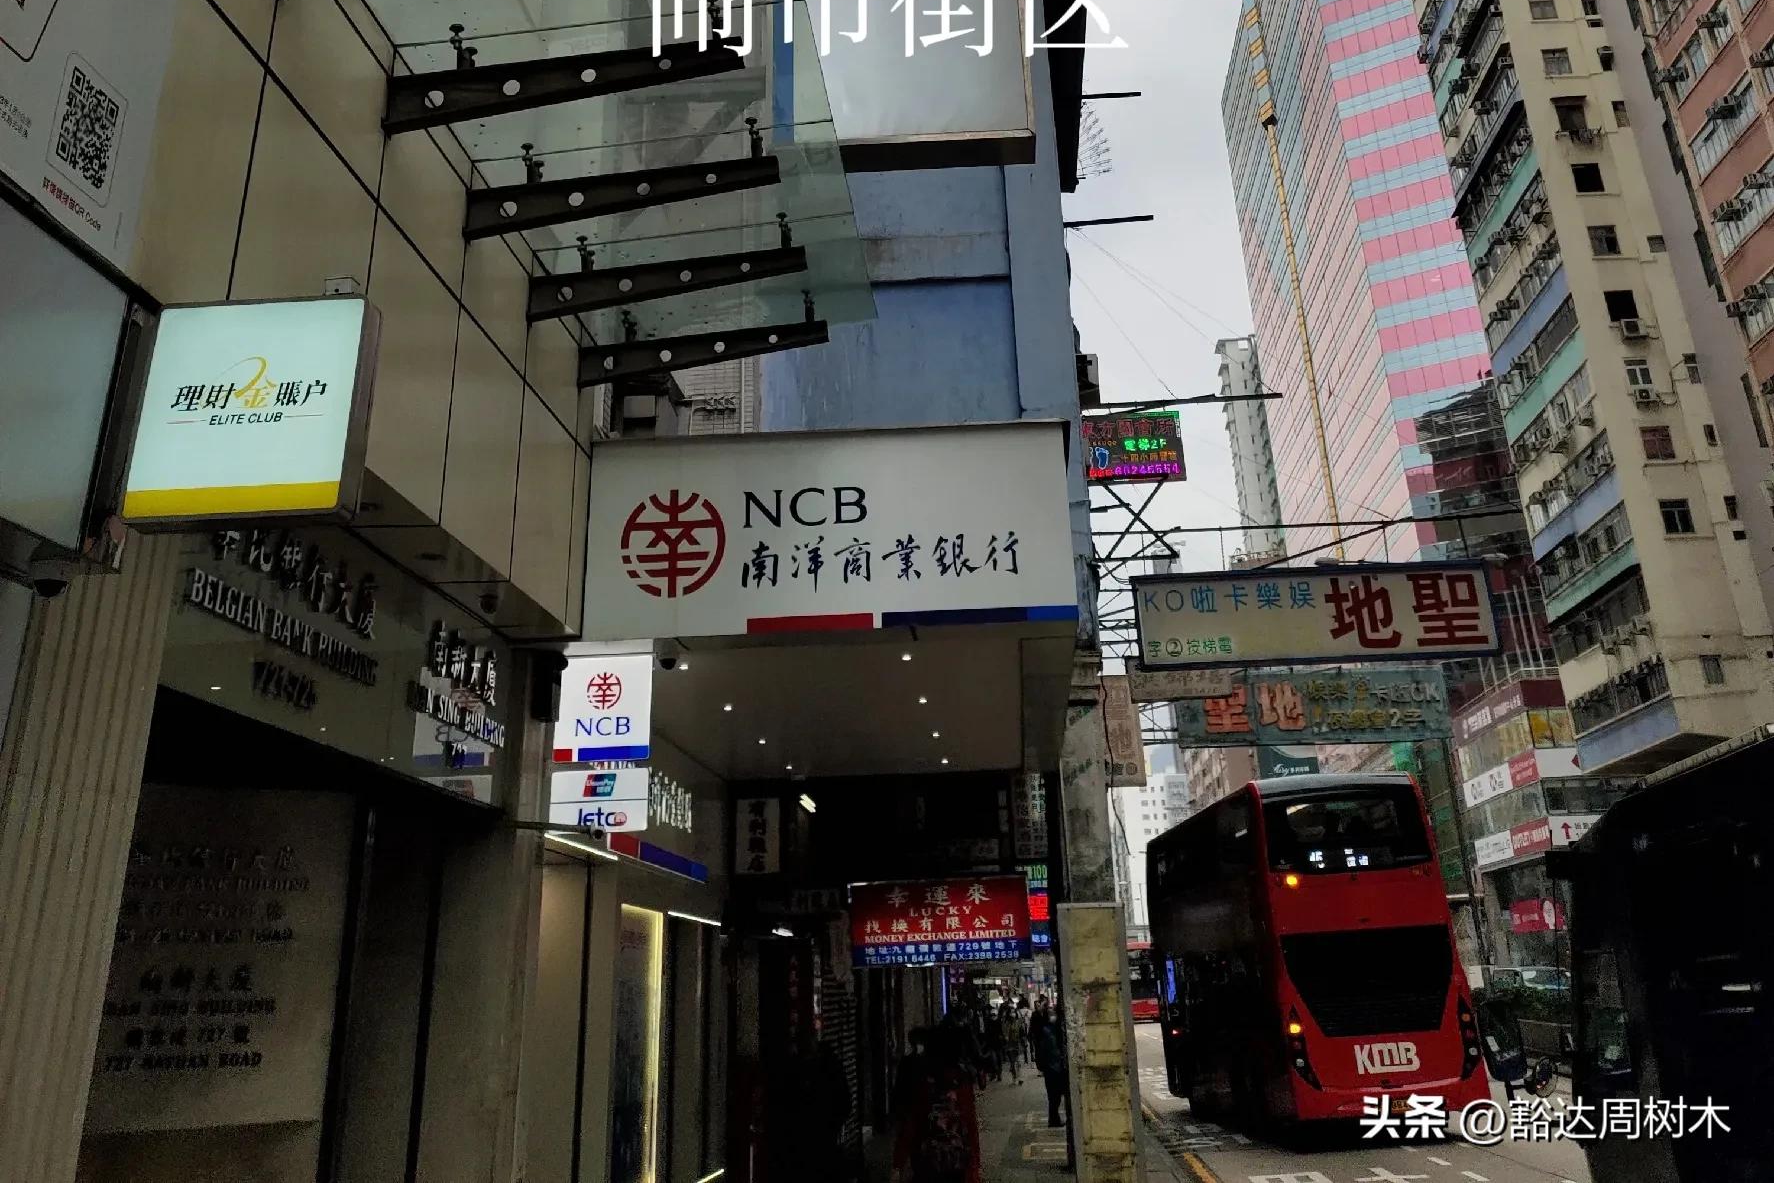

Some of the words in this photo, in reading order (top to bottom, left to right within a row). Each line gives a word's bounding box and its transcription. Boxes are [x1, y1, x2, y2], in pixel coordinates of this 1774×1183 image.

[209, 413, 245, 426] ELITE
[248, 411, 283, 424] CLUB
[743, 486, 868, 529] NCB
[741, 530, 1020, 593] 南洋商業銀行
[189, 567, 266, 633] BELGIAN
[437, 693, 460, 724] SING
[465, 710, 505, 748] BUILDING
[575, 715, 630, 737] NCB
[886, 882, 991, 908] 幸運來
[864, 913, 1014, 934] 找換有限公司
[910, 905, 972, 917] LUCKY
[864, 932, 904, 944] MONEY
[907, 930, 967, 942] EXCHANGE
[969, 928, 1016, 940] LIMITED
[1354, 1041, 1421, 1075] KMB
